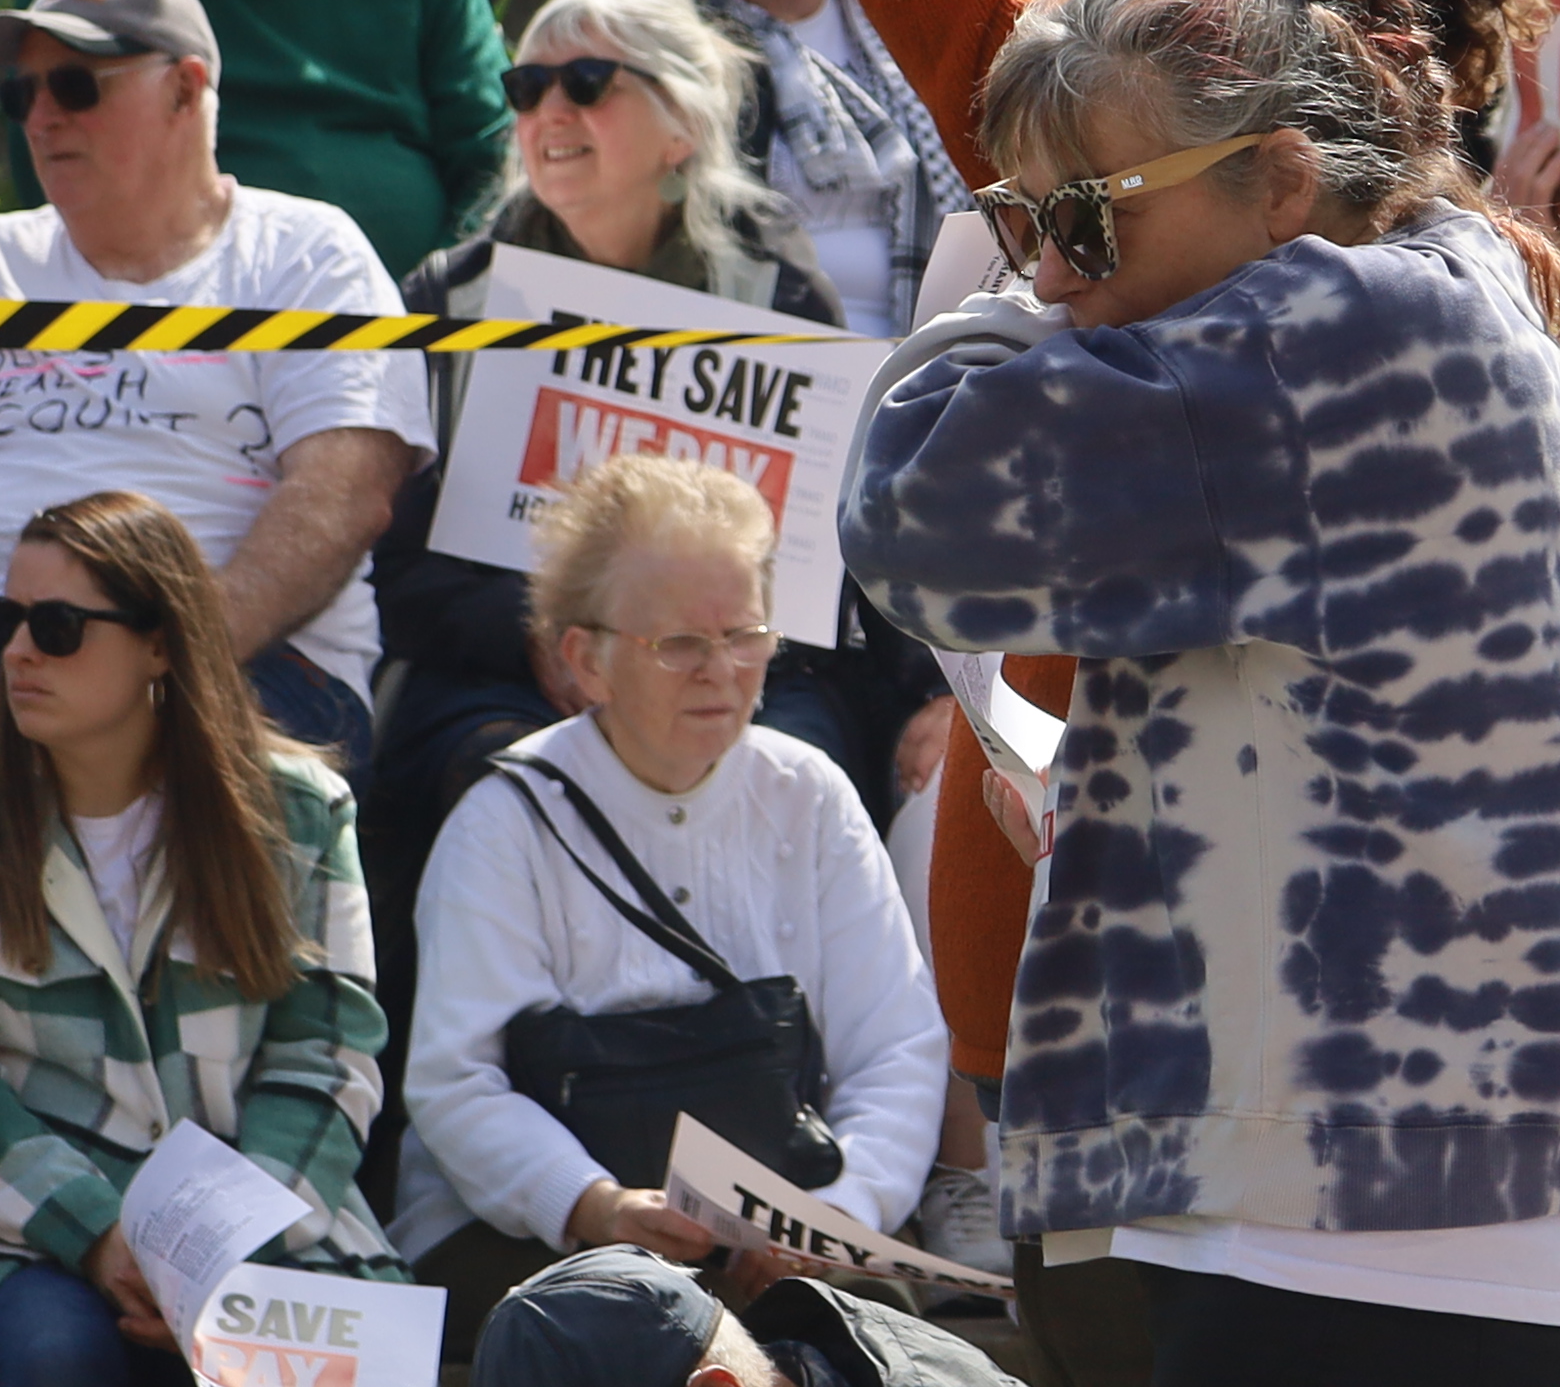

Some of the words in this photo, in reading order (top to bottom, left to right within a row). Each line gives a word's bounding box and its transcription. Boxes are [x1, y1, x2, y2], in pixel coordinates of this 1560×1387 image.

[551, 309, 675, 401] THEY
[683, 348, 813, 438] SAVE
[733, 1182, 875, 1266] THEY
[216, 1292, 363, 1349] SAVE
